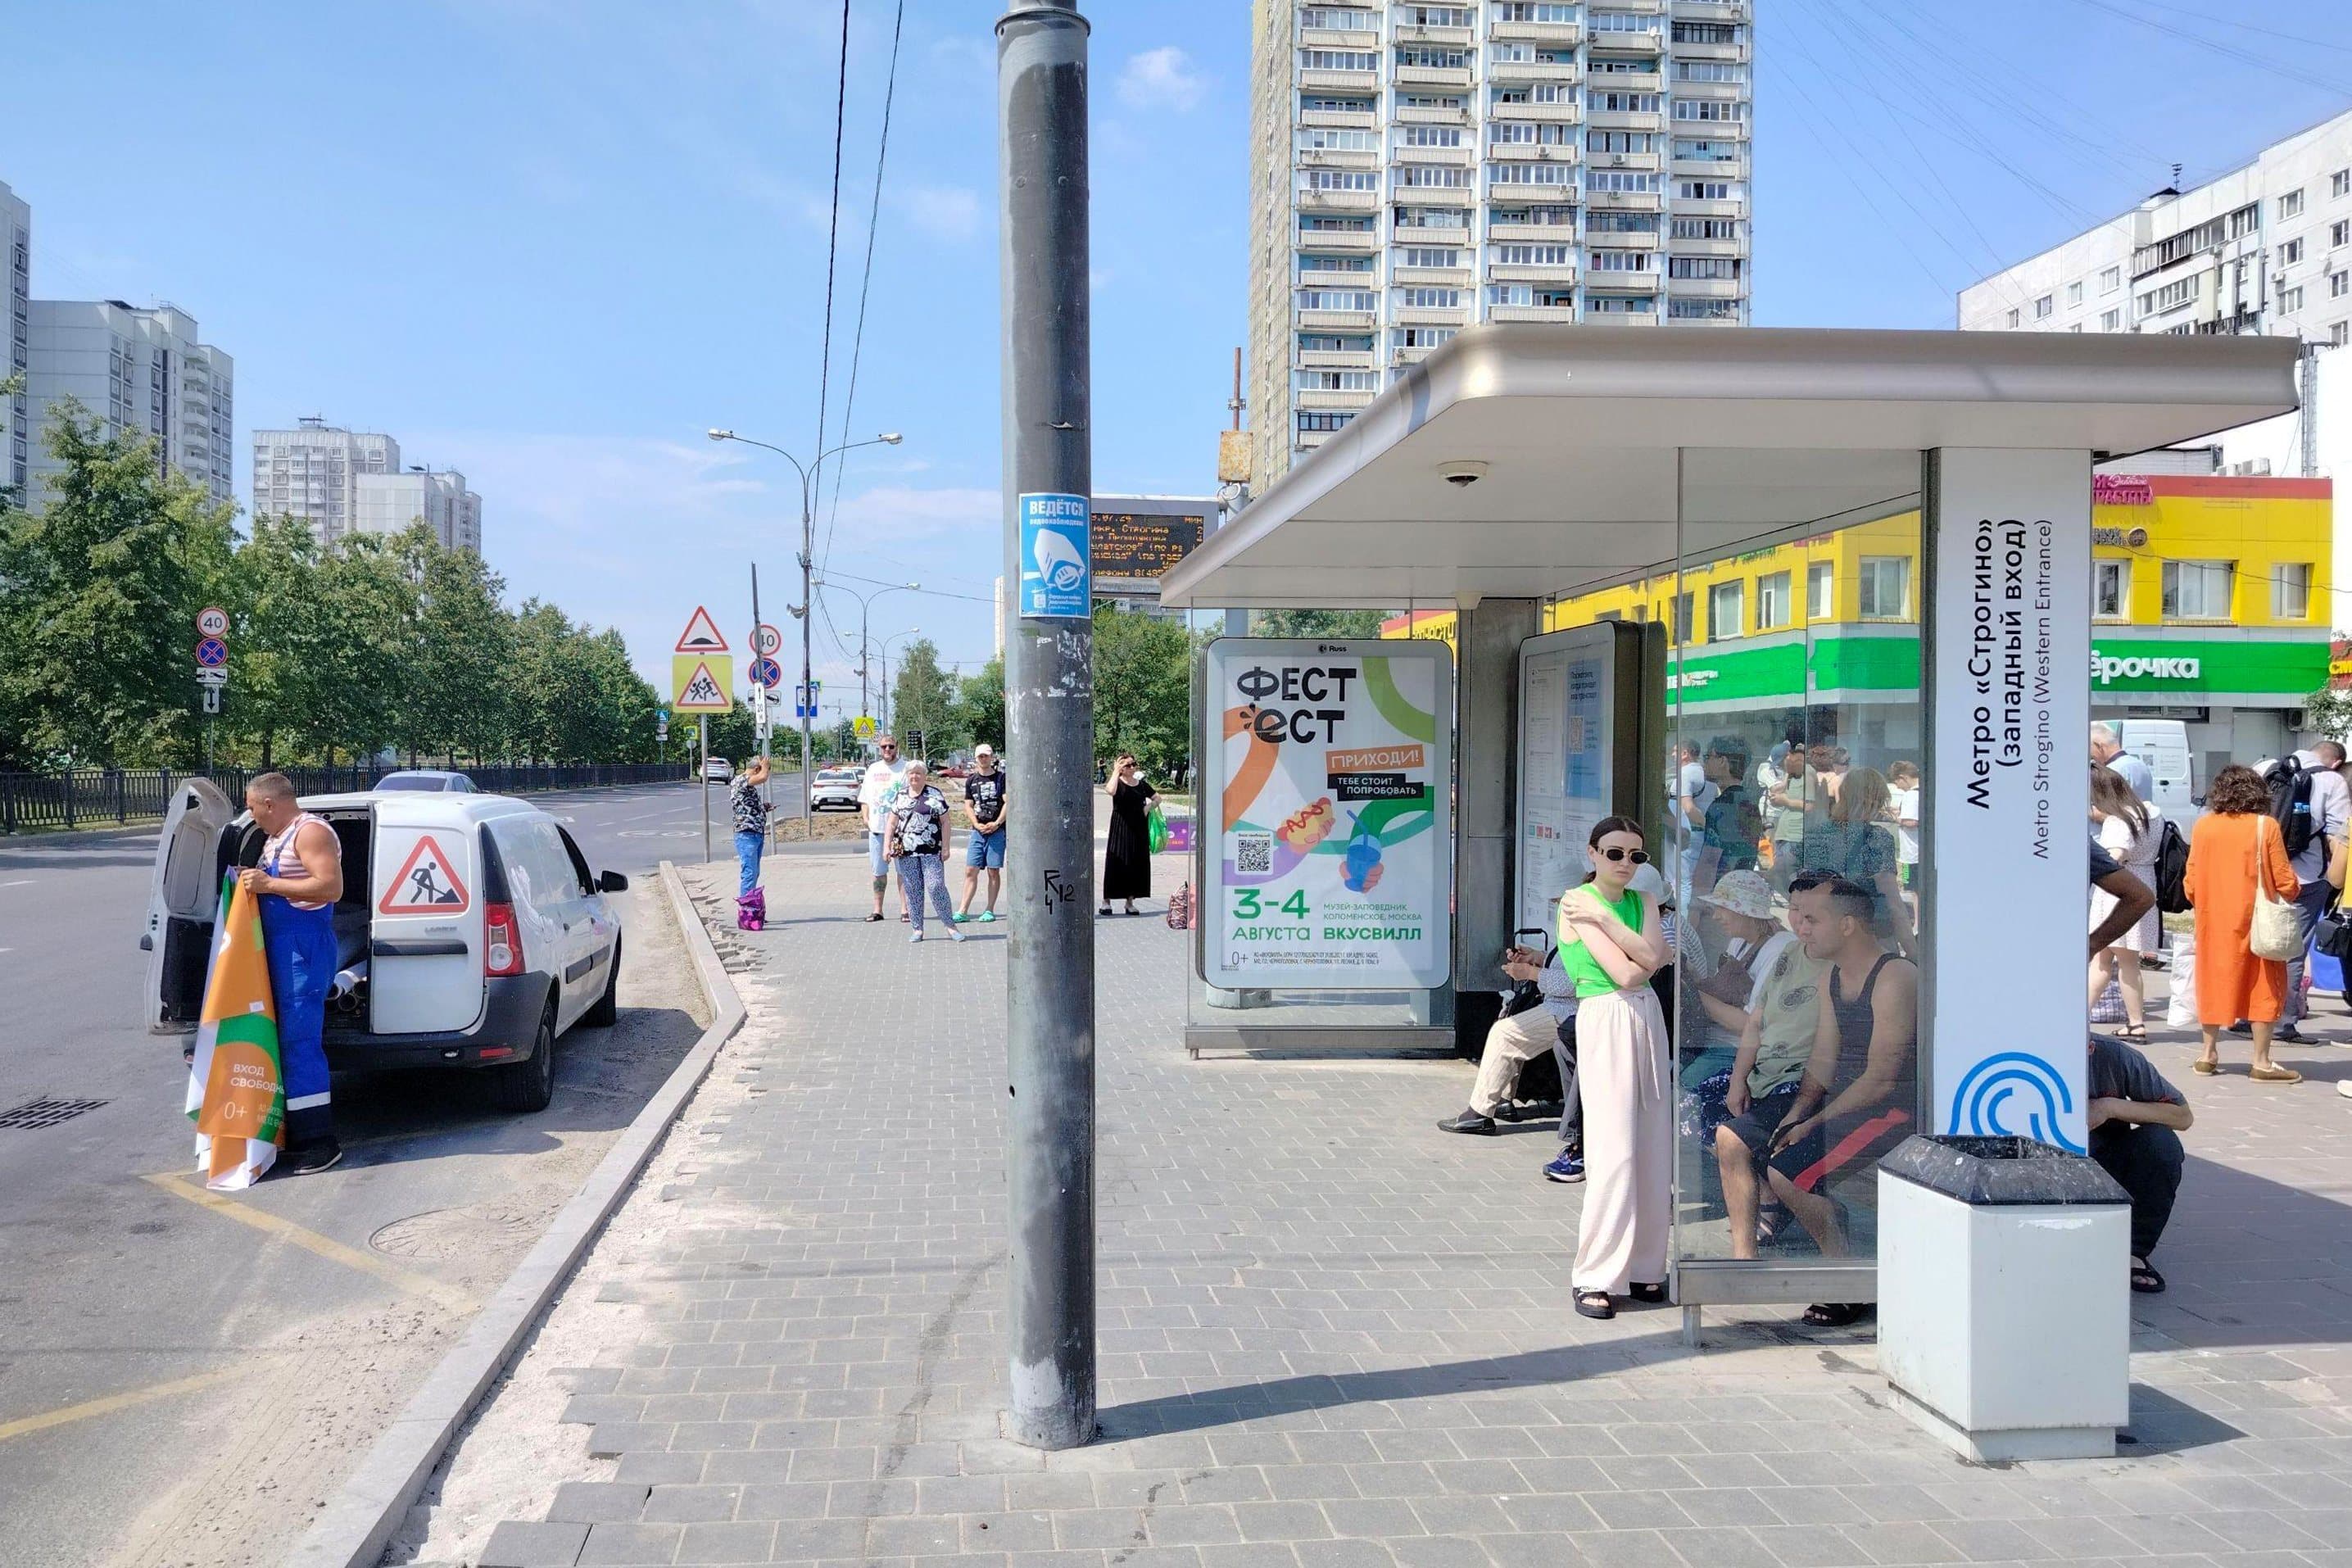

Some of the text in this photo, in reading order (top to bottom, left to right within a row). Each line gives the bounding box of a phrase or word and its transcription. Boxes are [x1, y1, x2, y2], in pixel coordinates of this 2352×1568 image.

[1029, 499, 1084, 517] ВЕДЁТСЯ
[203, 617, 223, 628] 40
[1996, 519, 2027, 767] (западный вход)
[1967, 519, 1996, 809] Метро «Строгино»
[1237, 666, 1357, 702] ФЕСТ
[2033, 520, 2053, 859] Metro Strogino (Western Entrance)
[1330, 749, 1420, 768] ПРИХОДИ!
[1347, 786, 1416, 795] ПОПРОБОВАТЬ
[1323, 903, 1407, 911] МУЗЕЙ-ЗАПОВЕДНИК
[1323, 913, 1386, 922] КОЛОМЕНСКОЕ,
[1323, 927, 1422, 940] ВКУСВИЛЛ
[1231, 951, 1249, 966] 0+
[233, 1063, 265, 1077] ВХОД
[224, 1101, 247, 1120] 0+
